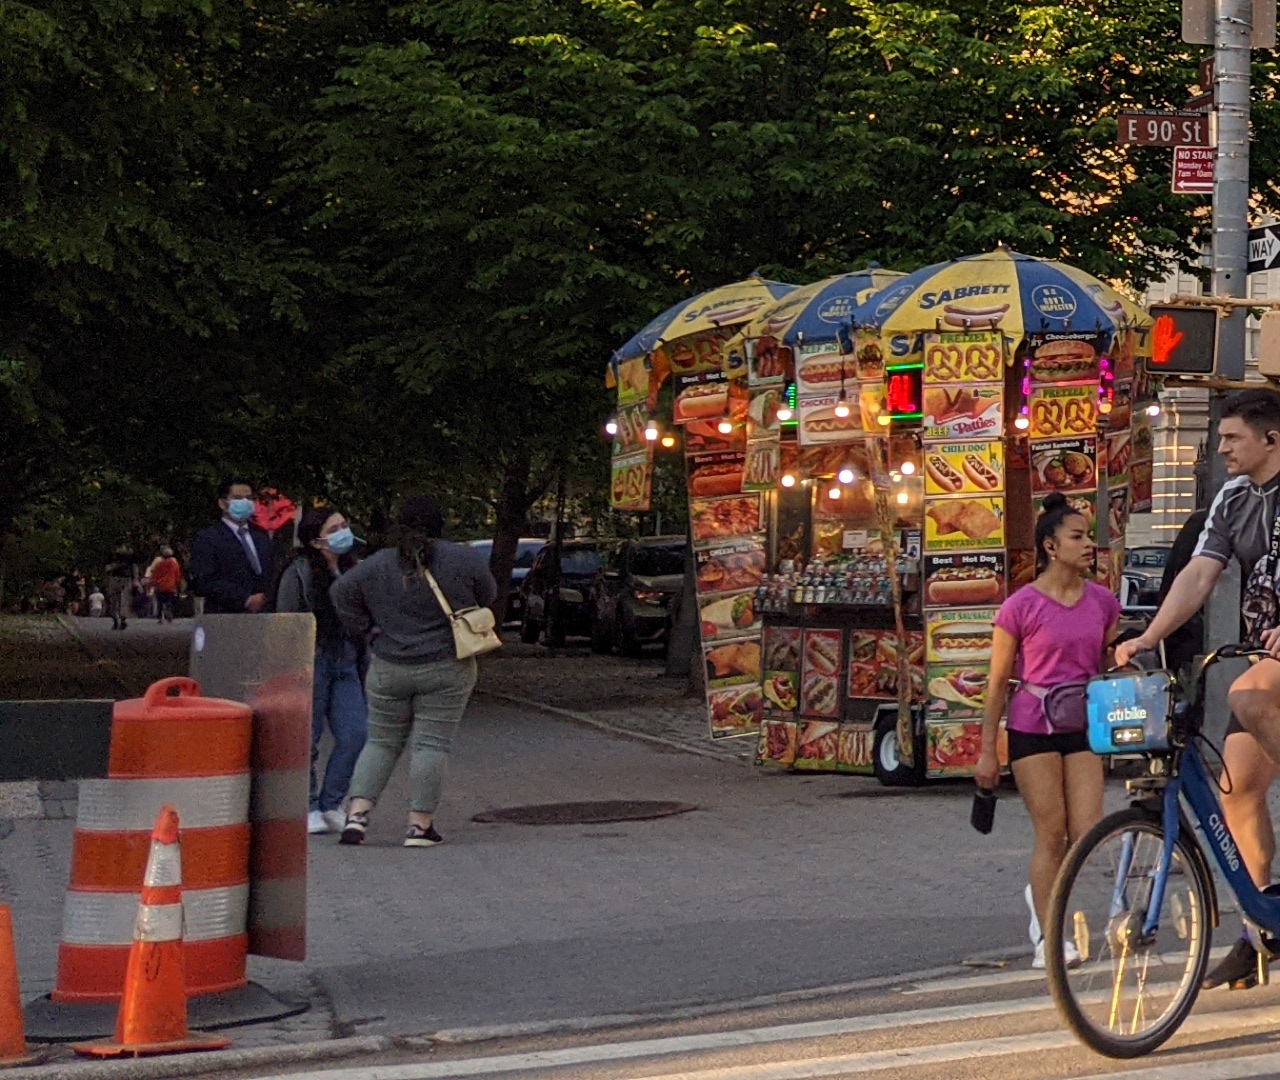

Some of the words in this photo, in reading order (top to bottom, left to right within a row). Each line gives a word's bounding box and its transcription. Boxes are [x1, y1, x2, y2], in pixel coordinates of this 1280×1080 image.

[1128, 120, 1138, 140] E
[1182, 121, 1201, 142] St
[1179, 151, 1191, 159] NO
[1251, 238, 1275, 259] WAY
[919, 283, 1011, 309] SABRETT
[940, 332, 988, 344] PRETZEL
[1043, 387, 1086, 398] PRETZEL
[801, 398, 836, 408] CHICKEN
[926, 426, 949, 437] BEEF
[953, 417, 997, 434] Patties
[968, 444, 986, 452] DOG
[932, 557, 954, 565] Best
